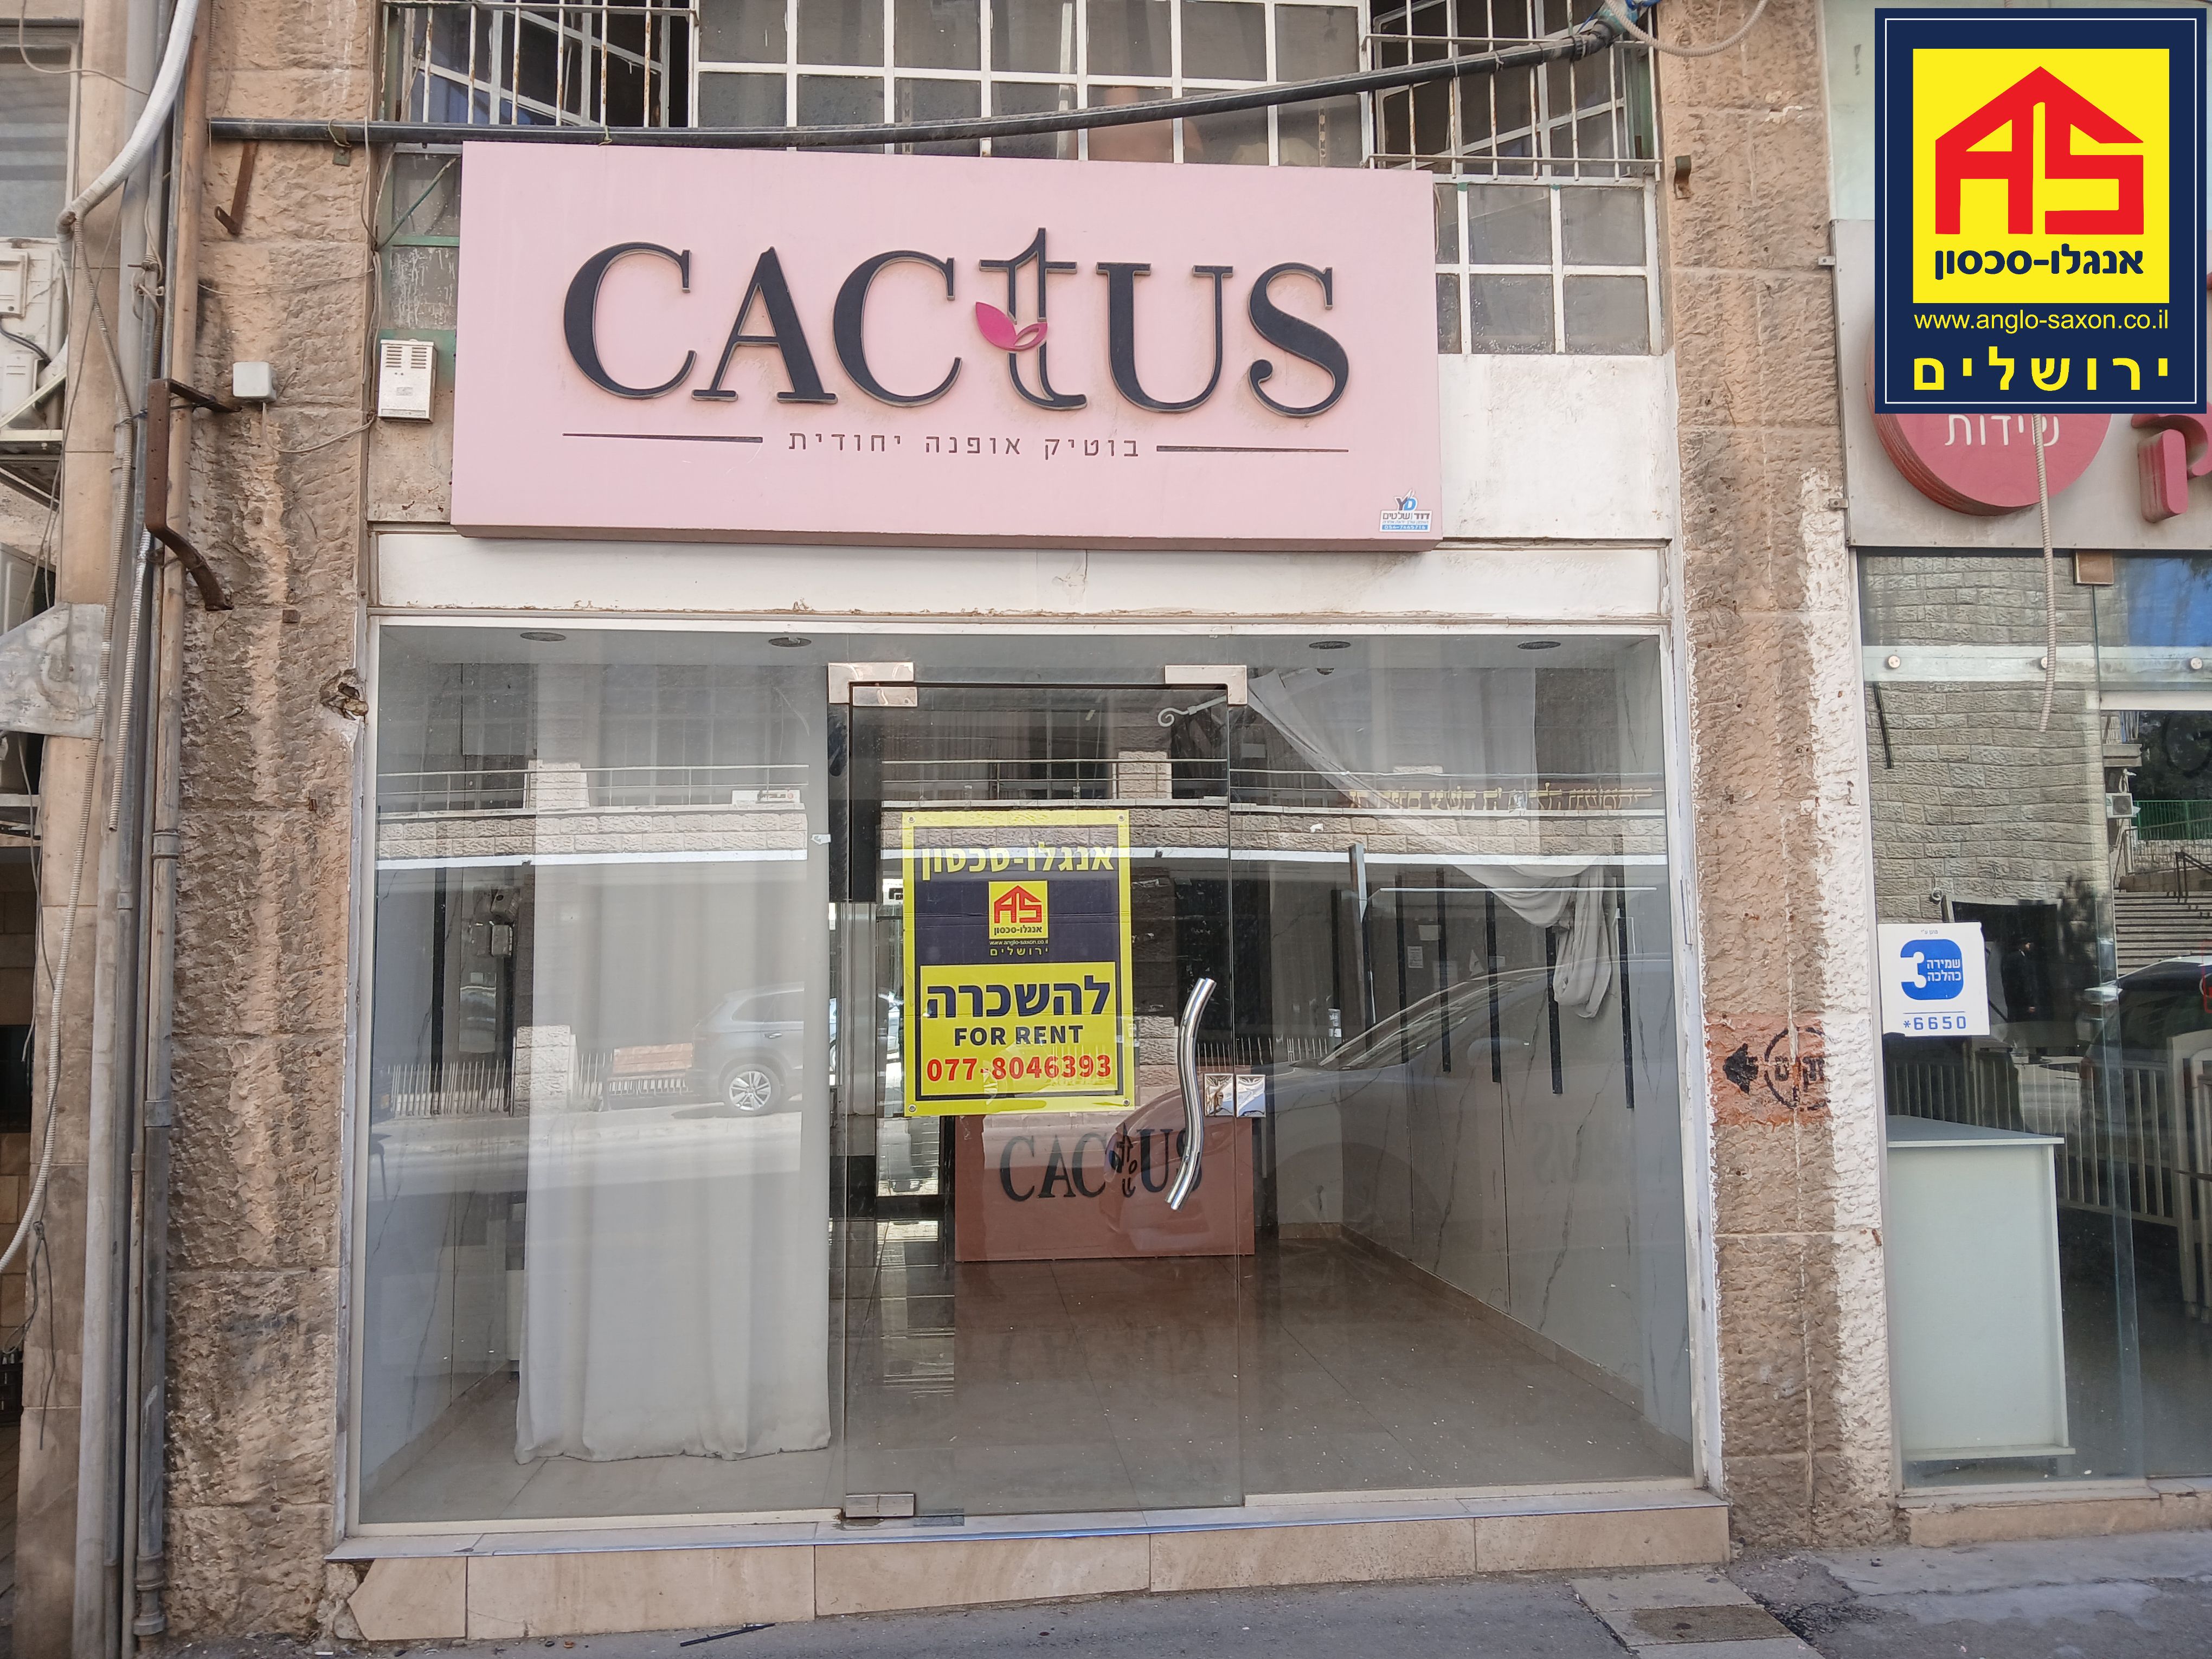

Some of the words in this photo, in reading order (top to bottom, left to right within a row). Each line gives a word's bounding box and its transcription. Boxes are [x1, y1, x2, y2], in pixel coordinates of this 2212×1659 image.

[788, 432, 901, 452] יחודית
[924, 435, 1021, 454] אופנה
[1044, 438, 1139, 460] בוטיק
[922, 841, 1114, 880] אנגלו-סכסון
[994, 925, 1043, 936] אנגלו-סכסון
[990, 946, 1049, 956] ירושלים
[1926, 958, 1961, 970] שמירה
[1926, 969, 1962, 982] כהלכה
[926, 974, 1111, 1018] להשכרה
[954, 1026, 1006, 1046] FOR
[1015, 1024, 1084, 1045] RENT
[927, 1054, 1111, 1082] 077-8046393
